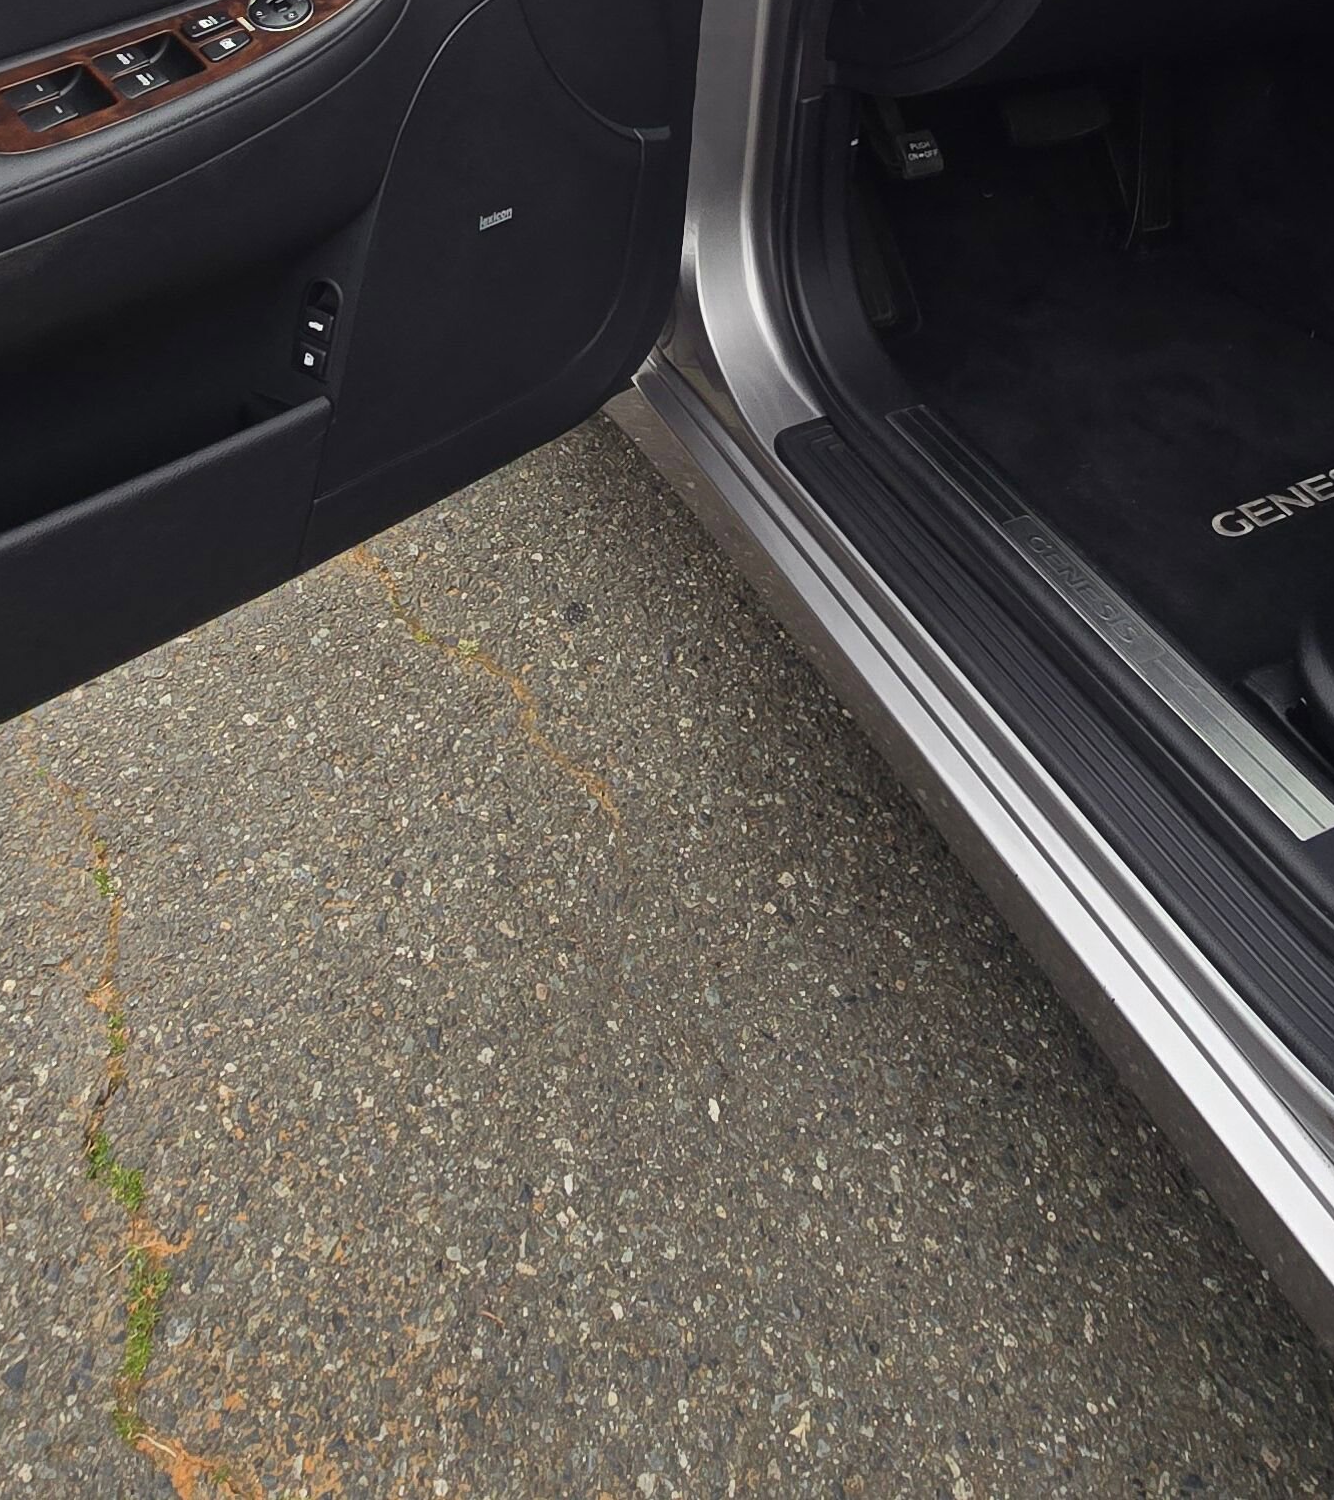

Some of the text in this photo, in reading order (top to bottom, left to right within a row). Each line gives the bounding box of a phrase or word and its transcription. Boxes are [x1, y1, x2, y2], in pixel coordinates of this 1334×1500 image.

[909, 141, 931, 151] PUSH
[479, 207, 513, 231] lexicon
[1028, 535, 1138, 645] GENESIS
